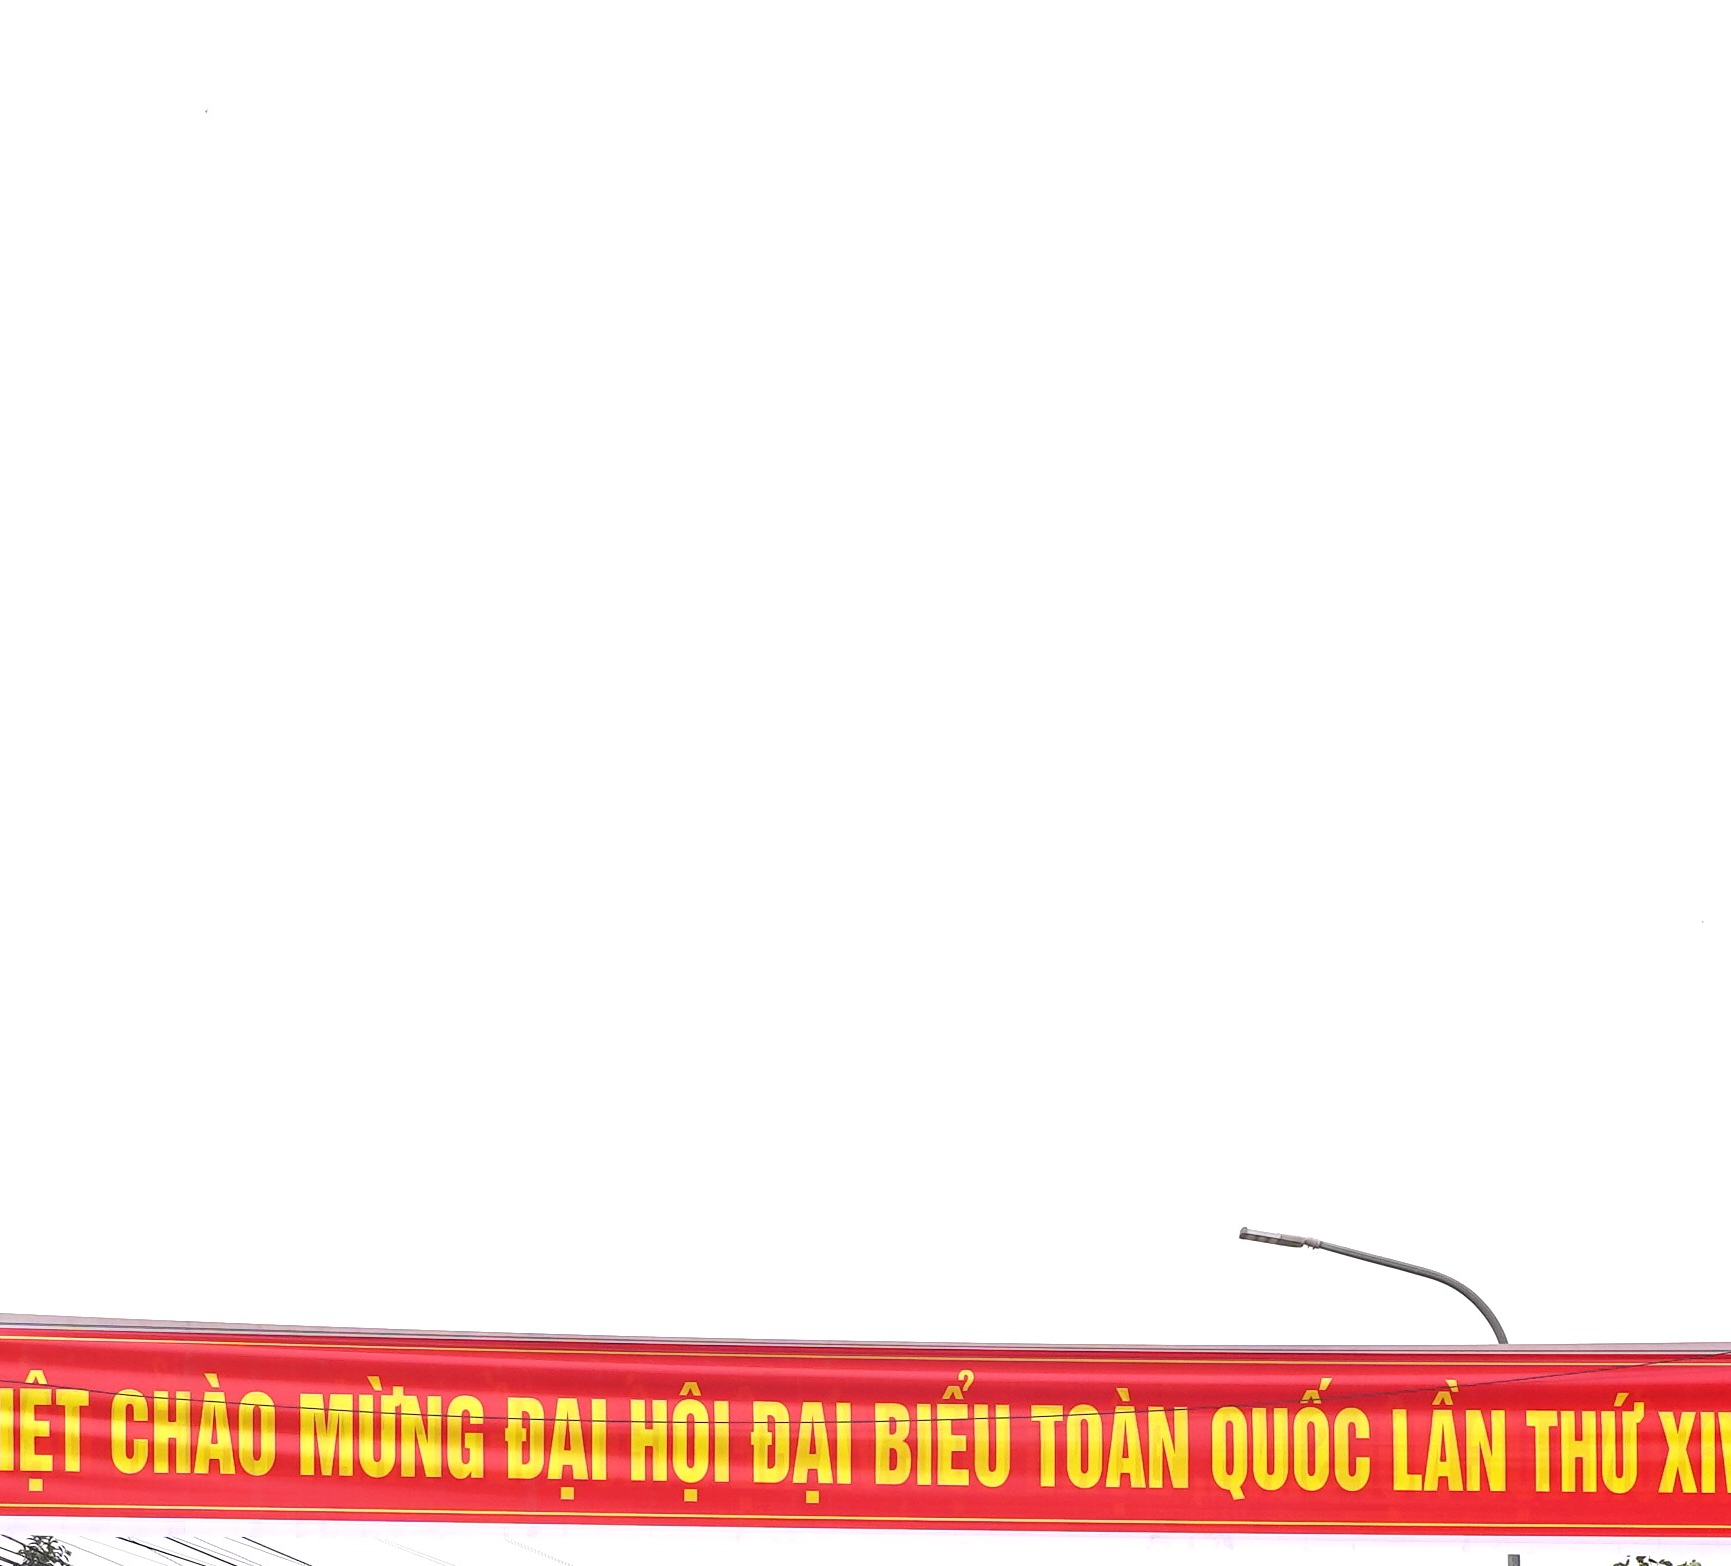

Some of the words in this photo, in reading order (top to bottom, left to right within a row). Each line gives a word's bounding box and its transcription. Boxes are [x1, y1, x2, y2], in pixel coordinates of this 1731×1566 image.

[111, 1373, 276, 1476] CHÀO
[299, 1376, 484, 1479] MỪNG
[504, 1397, 607, 1500] ĐẠI
[630, 1381, 729, 1502] HỘI
[750, 1401, 852, 1504] ĐẠI
[874, 1369, 1011, 1488] BIỂU
[1031, 1387, 1189, 1489] TOÀN
[1211, 1378, 1371, 1500] QUỐC
[1392, 1379, 1506, 1492] LẦN
[1525, 1392, 1645, 1494] THỨ
